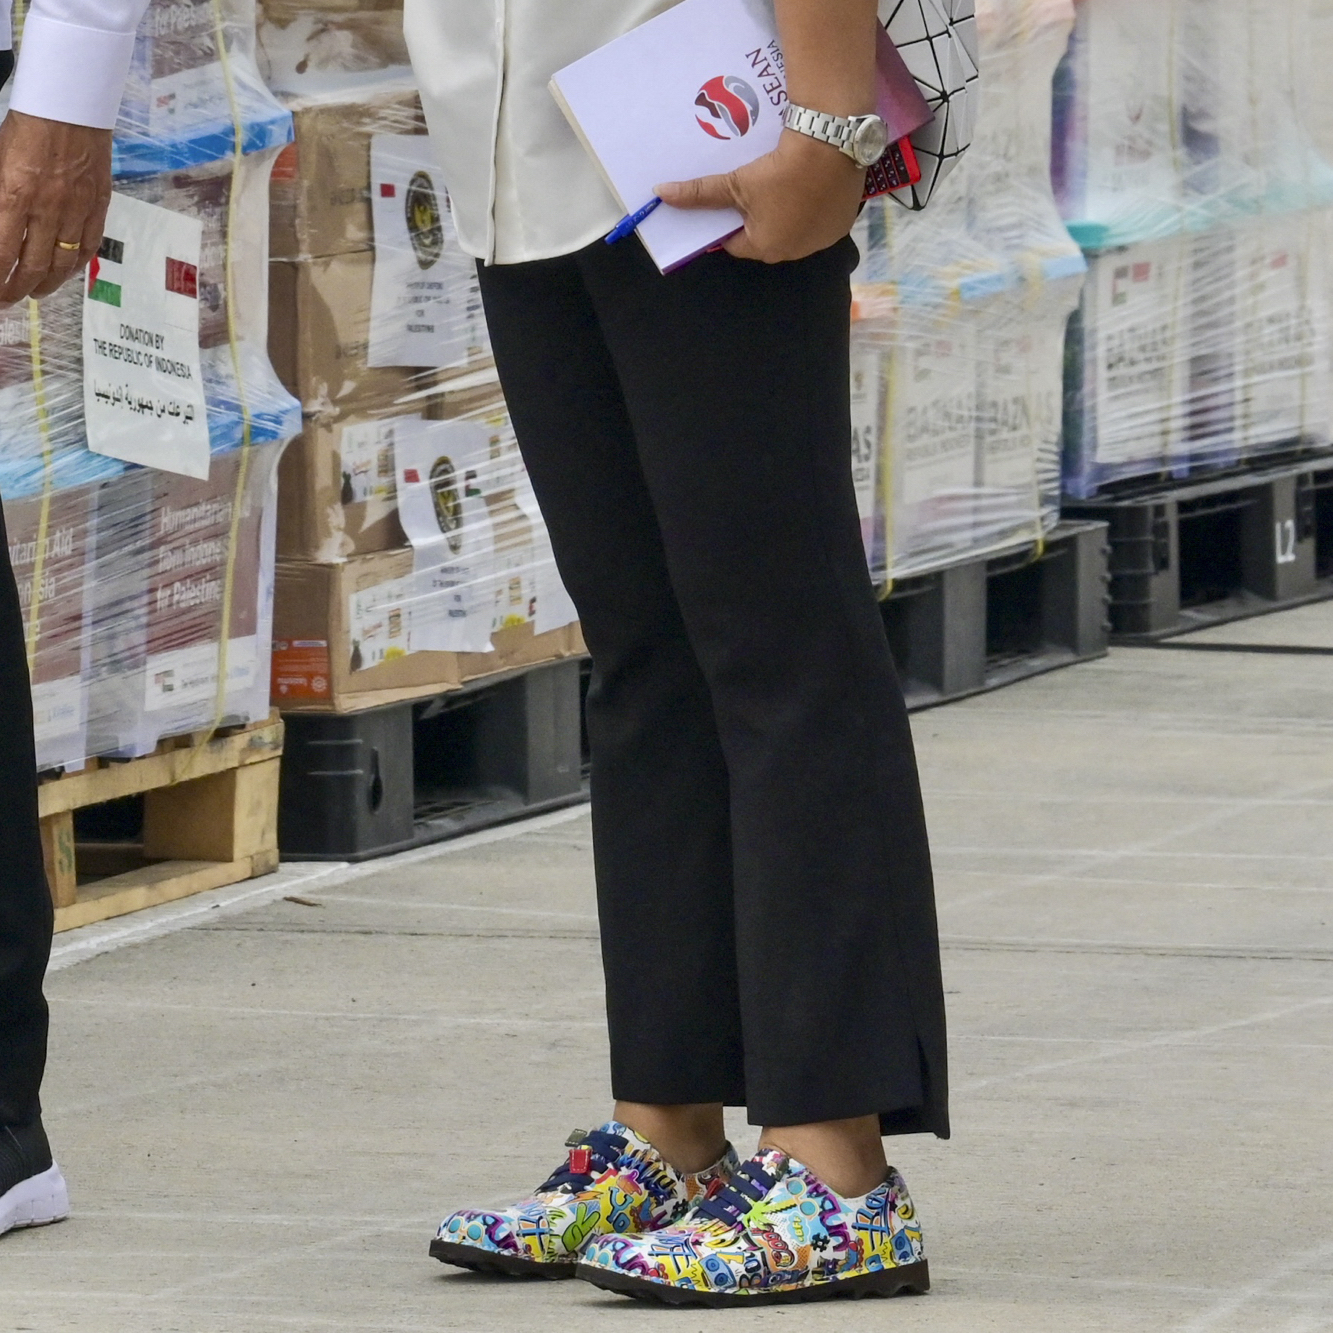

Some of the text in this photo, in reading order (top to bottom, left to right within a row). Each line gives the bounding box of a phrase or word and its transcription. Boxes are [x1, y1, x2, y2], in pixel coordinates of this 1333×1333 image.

[745, 47, 790, 117] SEAN
[120, 323, 165, 351] DONATION BY
[93, 338, 192, 382] THE REPUBLIC OF INDONESIA
